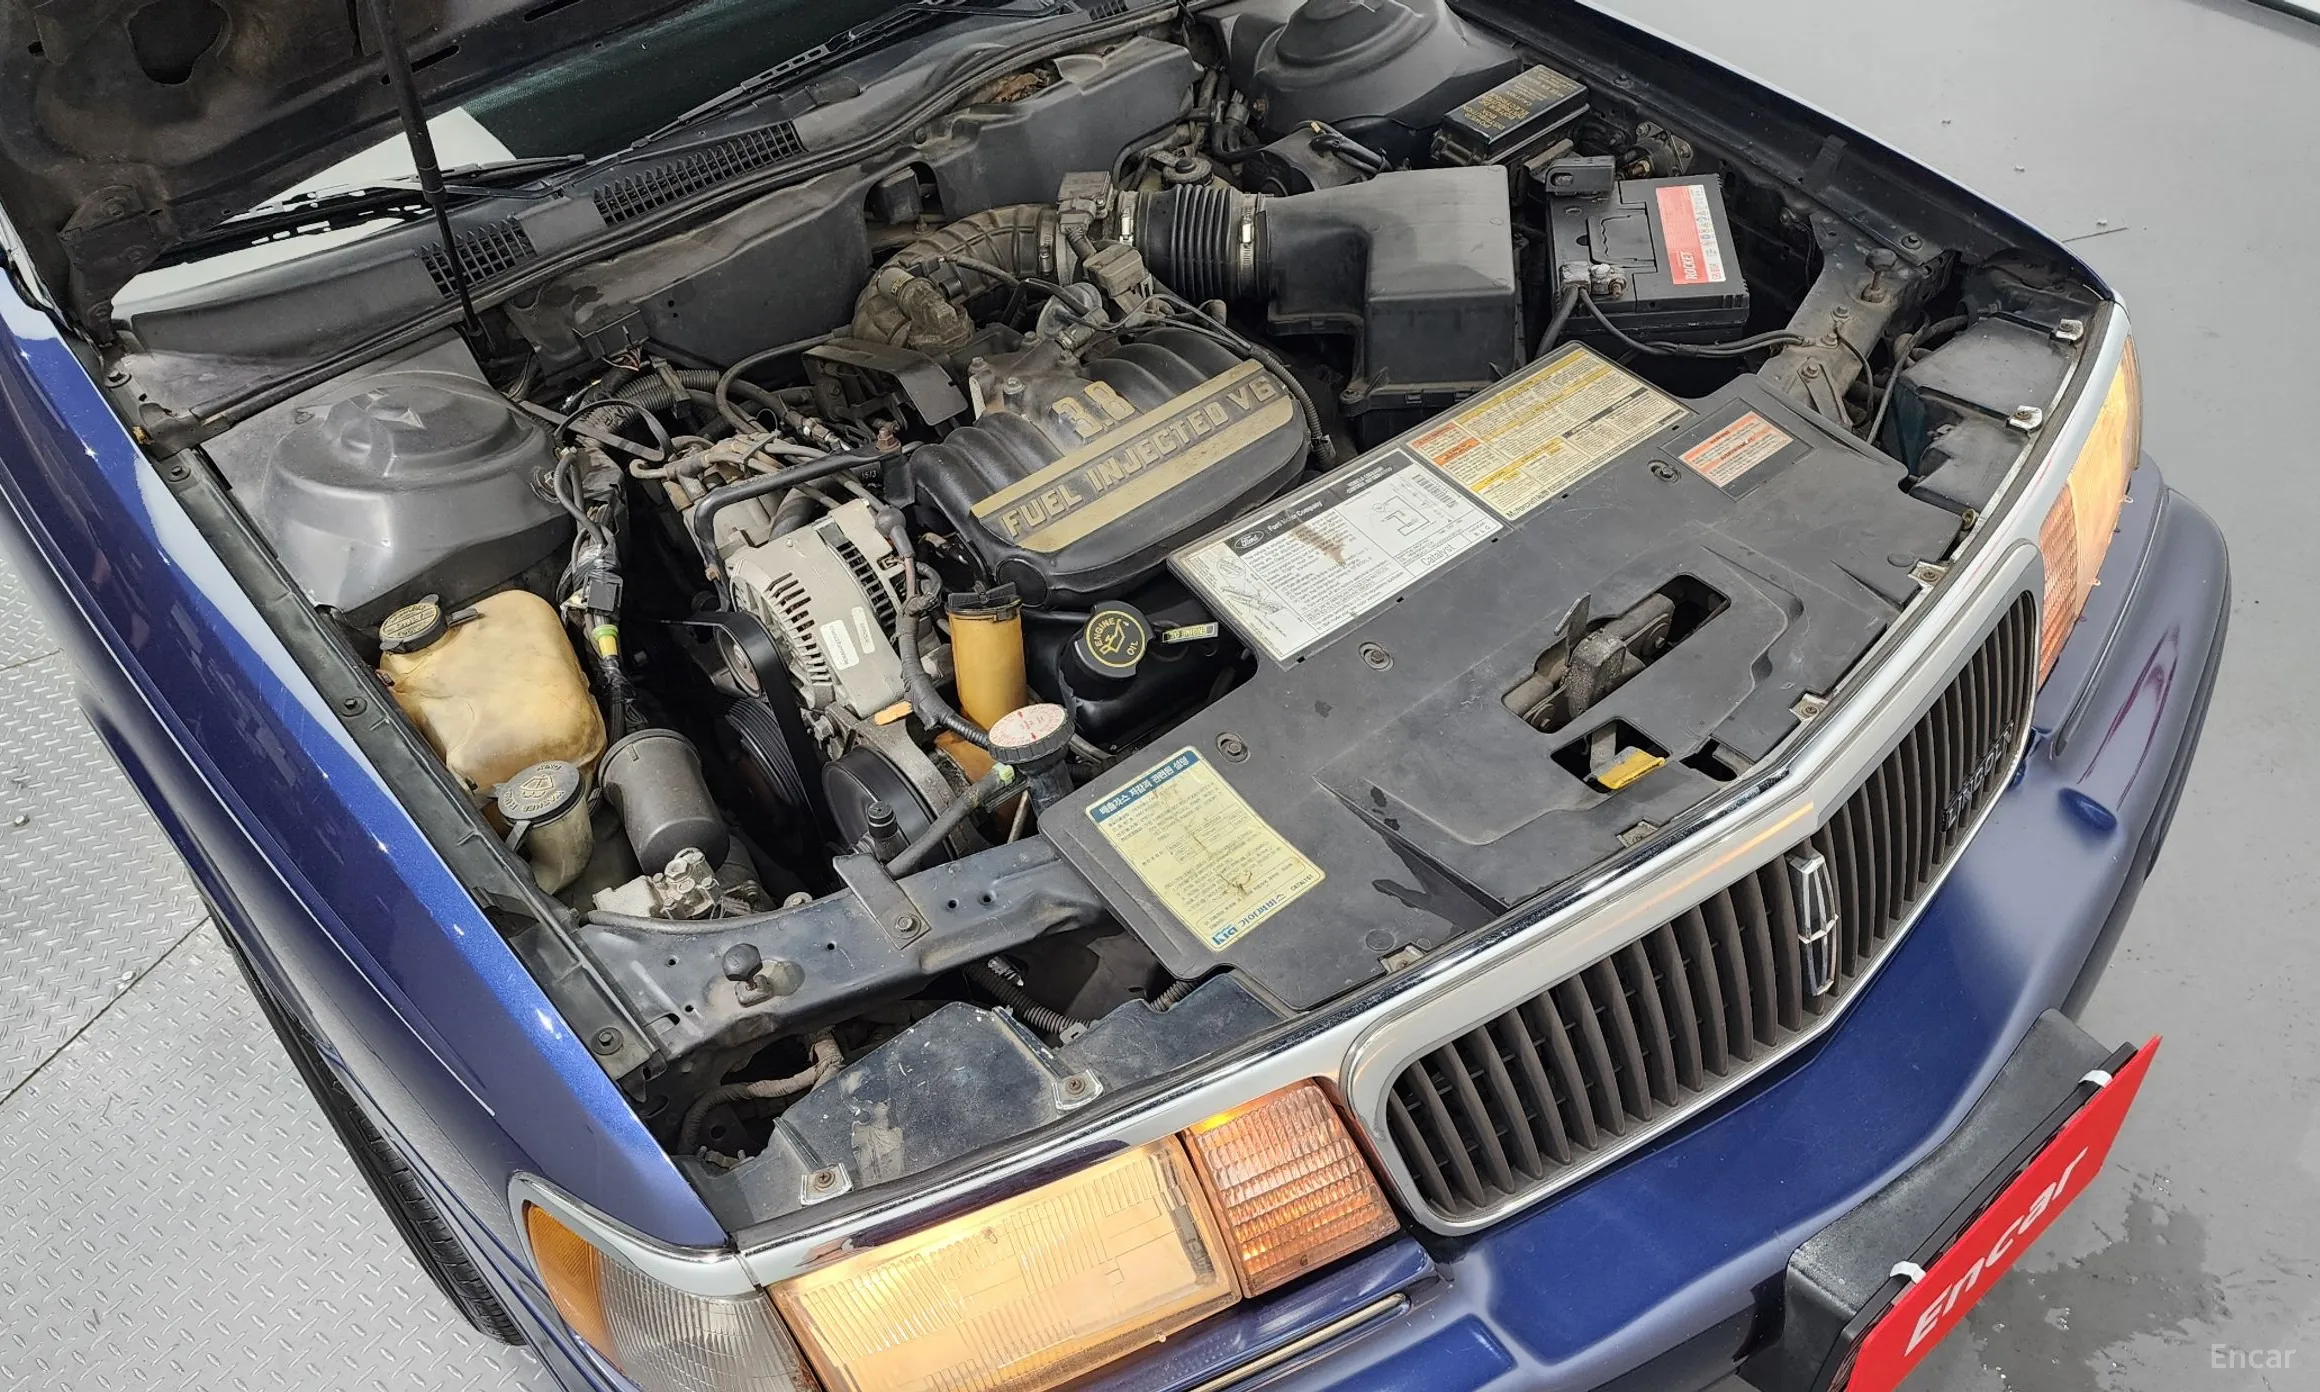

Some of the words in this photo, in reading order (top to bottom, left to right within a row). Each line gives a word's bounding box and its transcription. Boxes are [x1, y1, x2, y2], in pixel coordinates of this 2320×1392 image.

[1680, 251, 1699, 280] ROCKET
[1051, 382, 1137, 441] 3.8
[1001, 483, 1084, 539] FUEL
[1084, 400, 1231, 493] INJECTED
[1227, 375, 1278, 413] V6
[1268, 520, 1283, 532] Ford
[1295, 501, 1323, 518] Company
[1421, 543, 1456, 566] Catalyst
[1093, 617, 1116, 648] ENGINE
[1127, 640, 1139, 656] OIL
[1098, 793, 1132, 816] 배출가스
[1130, 781, 1154, 801] 저감과
[1153, 768, 1174, 787] 관련된
[1173, 756, 1190, 772] 설명
[1942, 721, 2014, 831] LINCOLN
[1904, 1146, 2089, 1358] Encar
